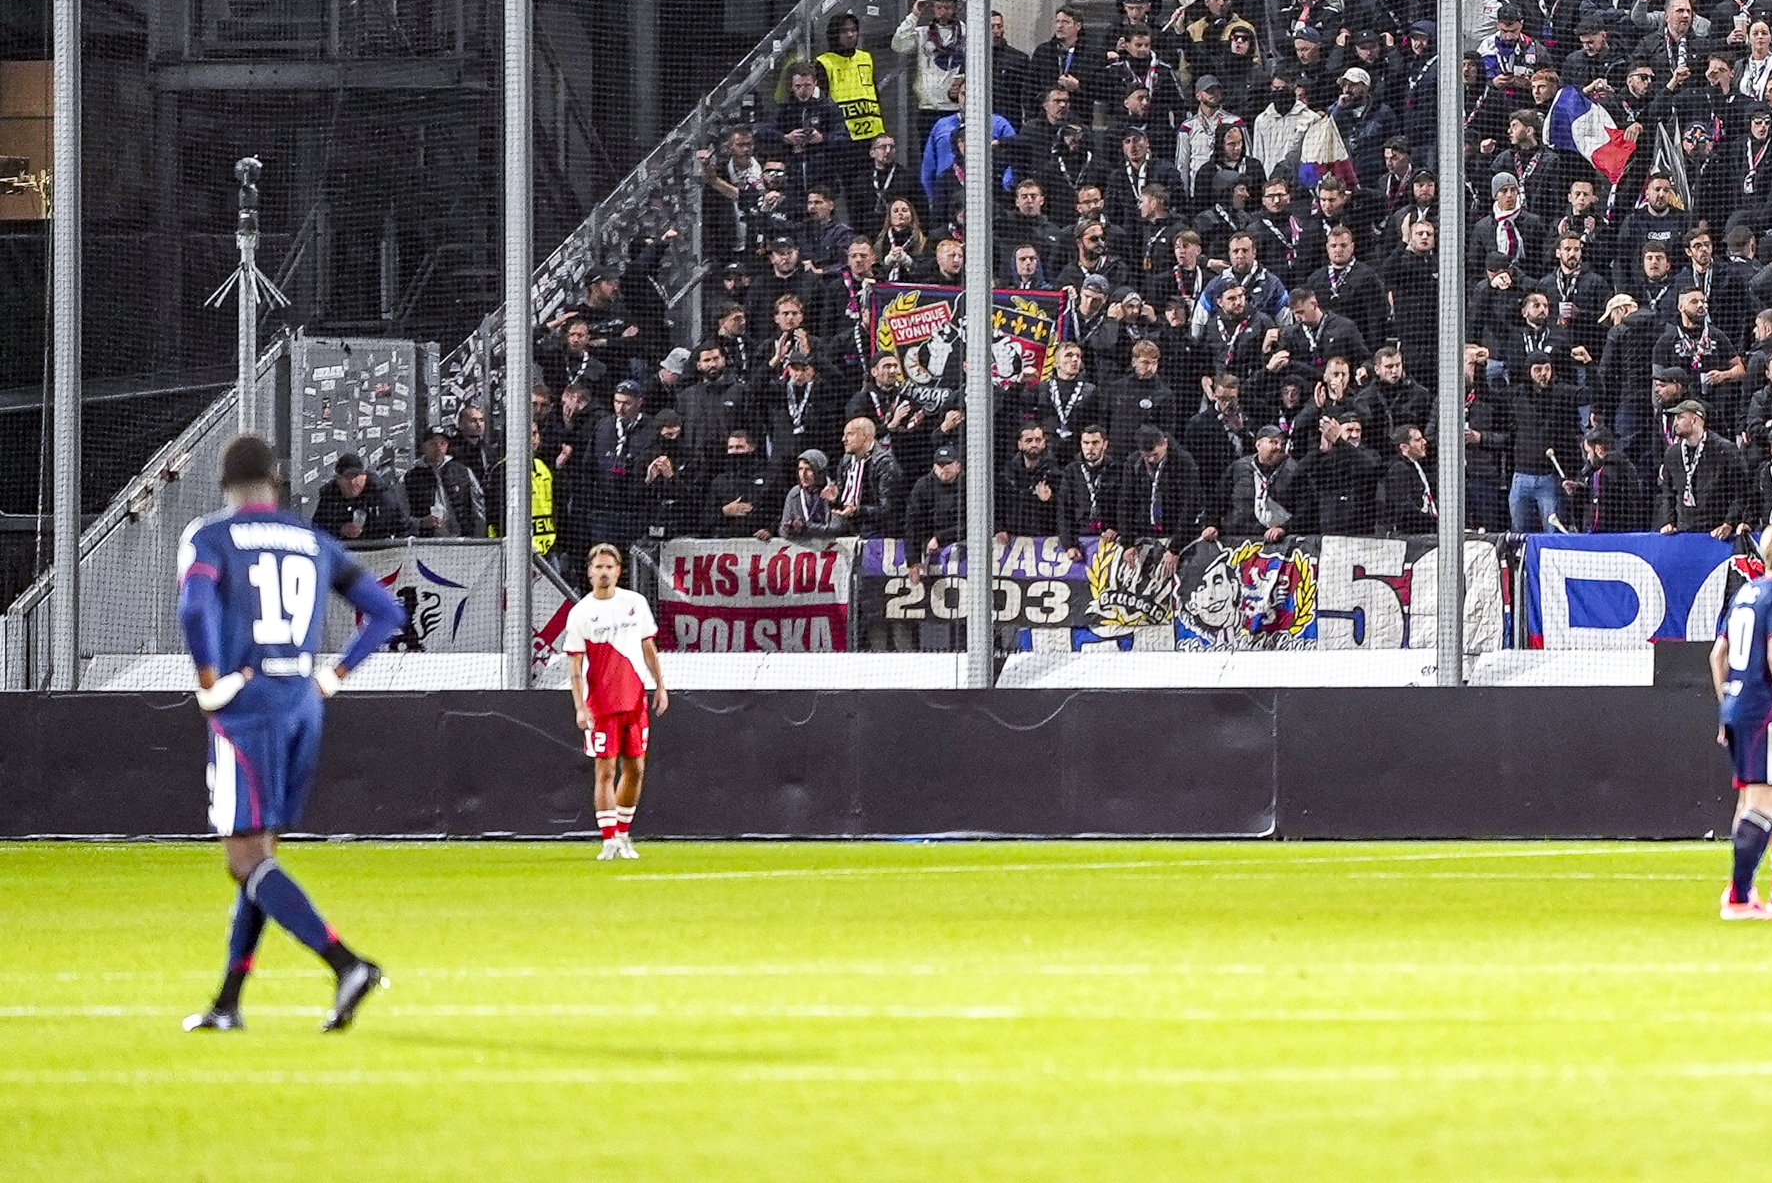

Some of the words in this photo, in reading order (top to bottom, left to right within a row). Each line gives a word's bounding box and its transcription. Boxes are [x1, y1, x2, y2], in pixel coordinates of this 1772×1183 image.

[855, 121, 871, 135] 22
[890, 307, 947, 331] OLYMPIQUE
[748, 543, 840, 597] ŁÓDŹ
[248, 551, 317, 647] 19
[884, 577, 1072, 624] 2003
[674, 613, 835, 652] POLSKA
